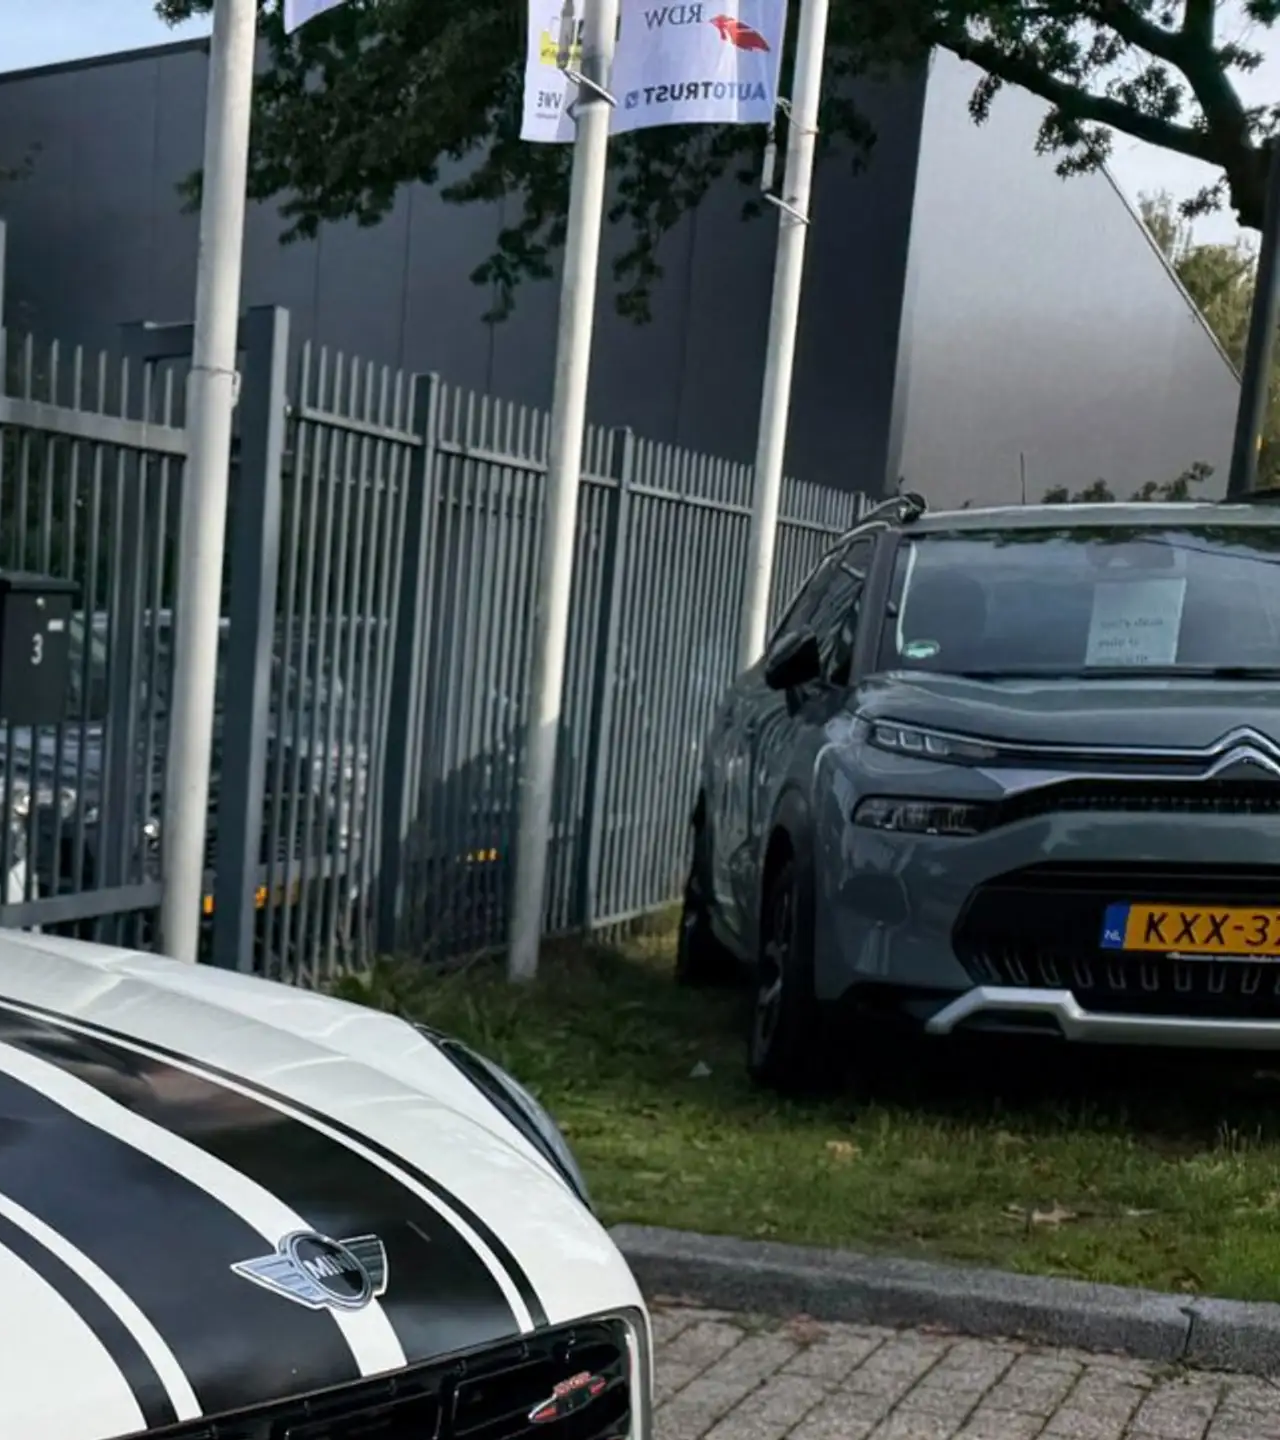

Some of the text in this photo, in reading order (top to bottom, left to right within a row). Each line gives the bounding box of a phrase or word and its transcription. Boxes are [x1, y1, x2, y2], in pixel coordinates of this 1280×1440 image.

[30, 632, 44, 665] 3
[1144, 911, 1280, 946] KXX-3
[302, 1252, 358, 1280] MINI
